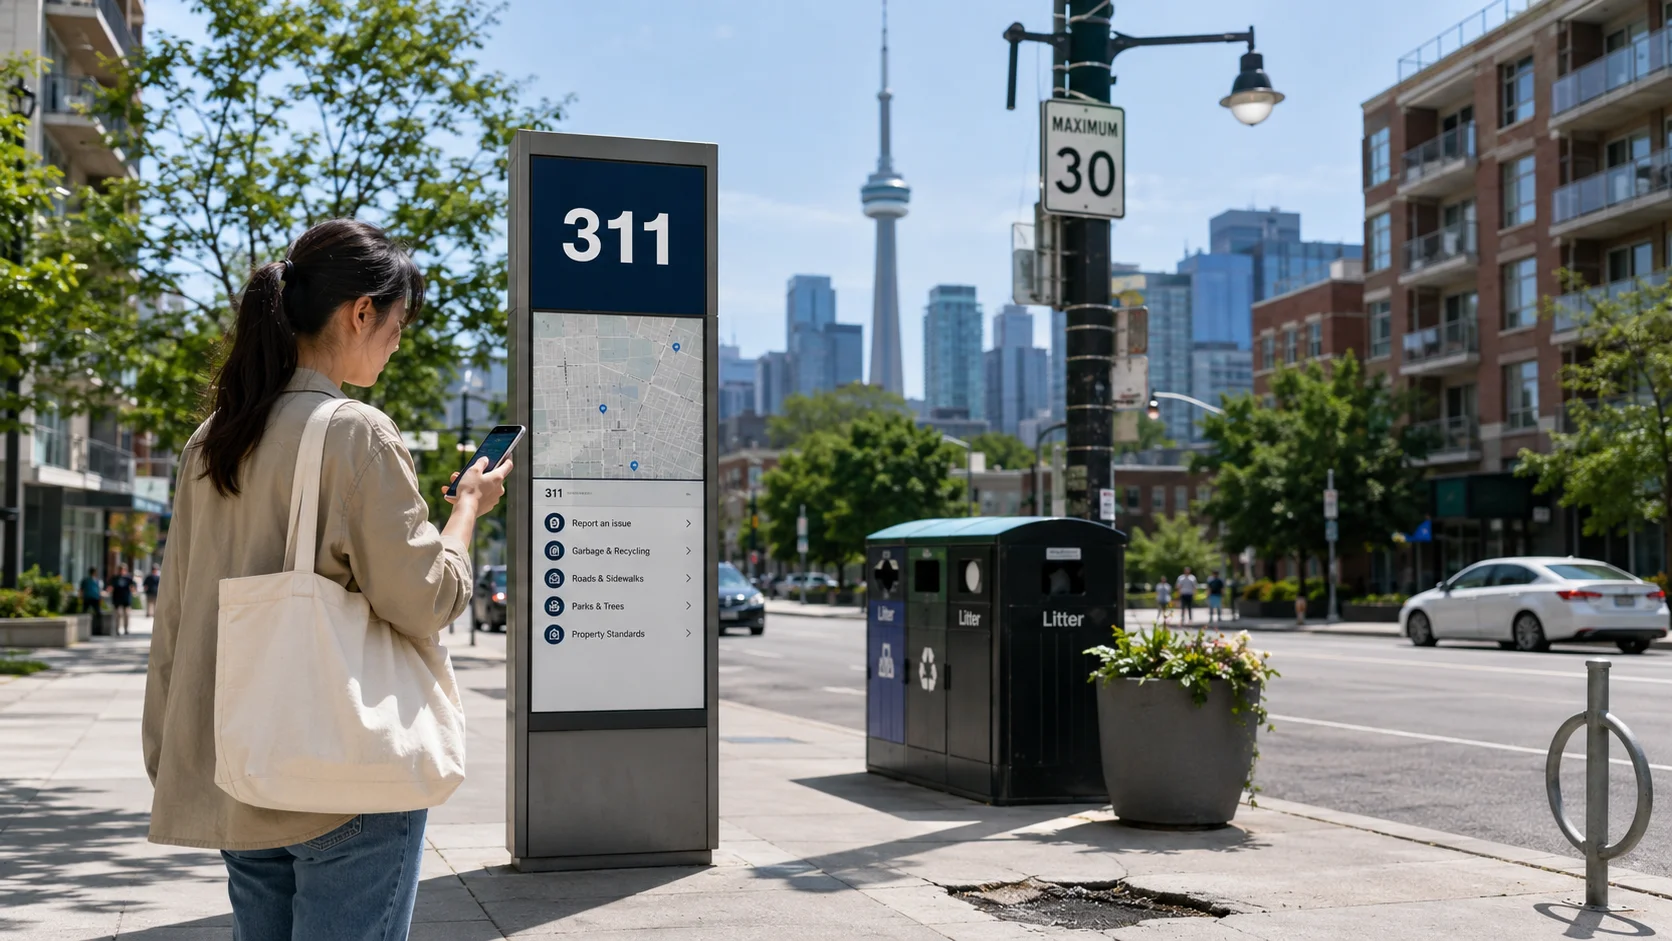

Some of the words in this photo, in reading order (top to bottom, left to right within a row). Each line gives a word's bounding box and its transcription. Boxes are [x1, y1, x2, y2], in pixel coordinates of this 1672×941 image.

[1052, 115, 1118, 137] MAXIMUM
[1055, 147, 1116, 198] 30
[562, 207, 669, 266] 311
[545, 488, 563, 498] 311
[572, 518, 599, 529] Report
[600, 519, 610, 527] an
[611, 518, 632, 527] issue
[572, 546, 605, 557] Garbage
[606, 547, 613, 555] &
[614, 546, 651, 557] Recycling
[572, 574, 597, 583] Roads
[598, 574, 604, 583] &
[606, 574, 645, 583] Sidewalks
[572, 601, 595, 611] Parks
[596, 602, 602, 611] &
[604, 602, 625, 611] Trees
[958, 609, 981, 627] Litter
[1042, 611, 1085, 627] Litter
[572, 629, 606, 640] Property
[606, 629, 646, 639] Standards
